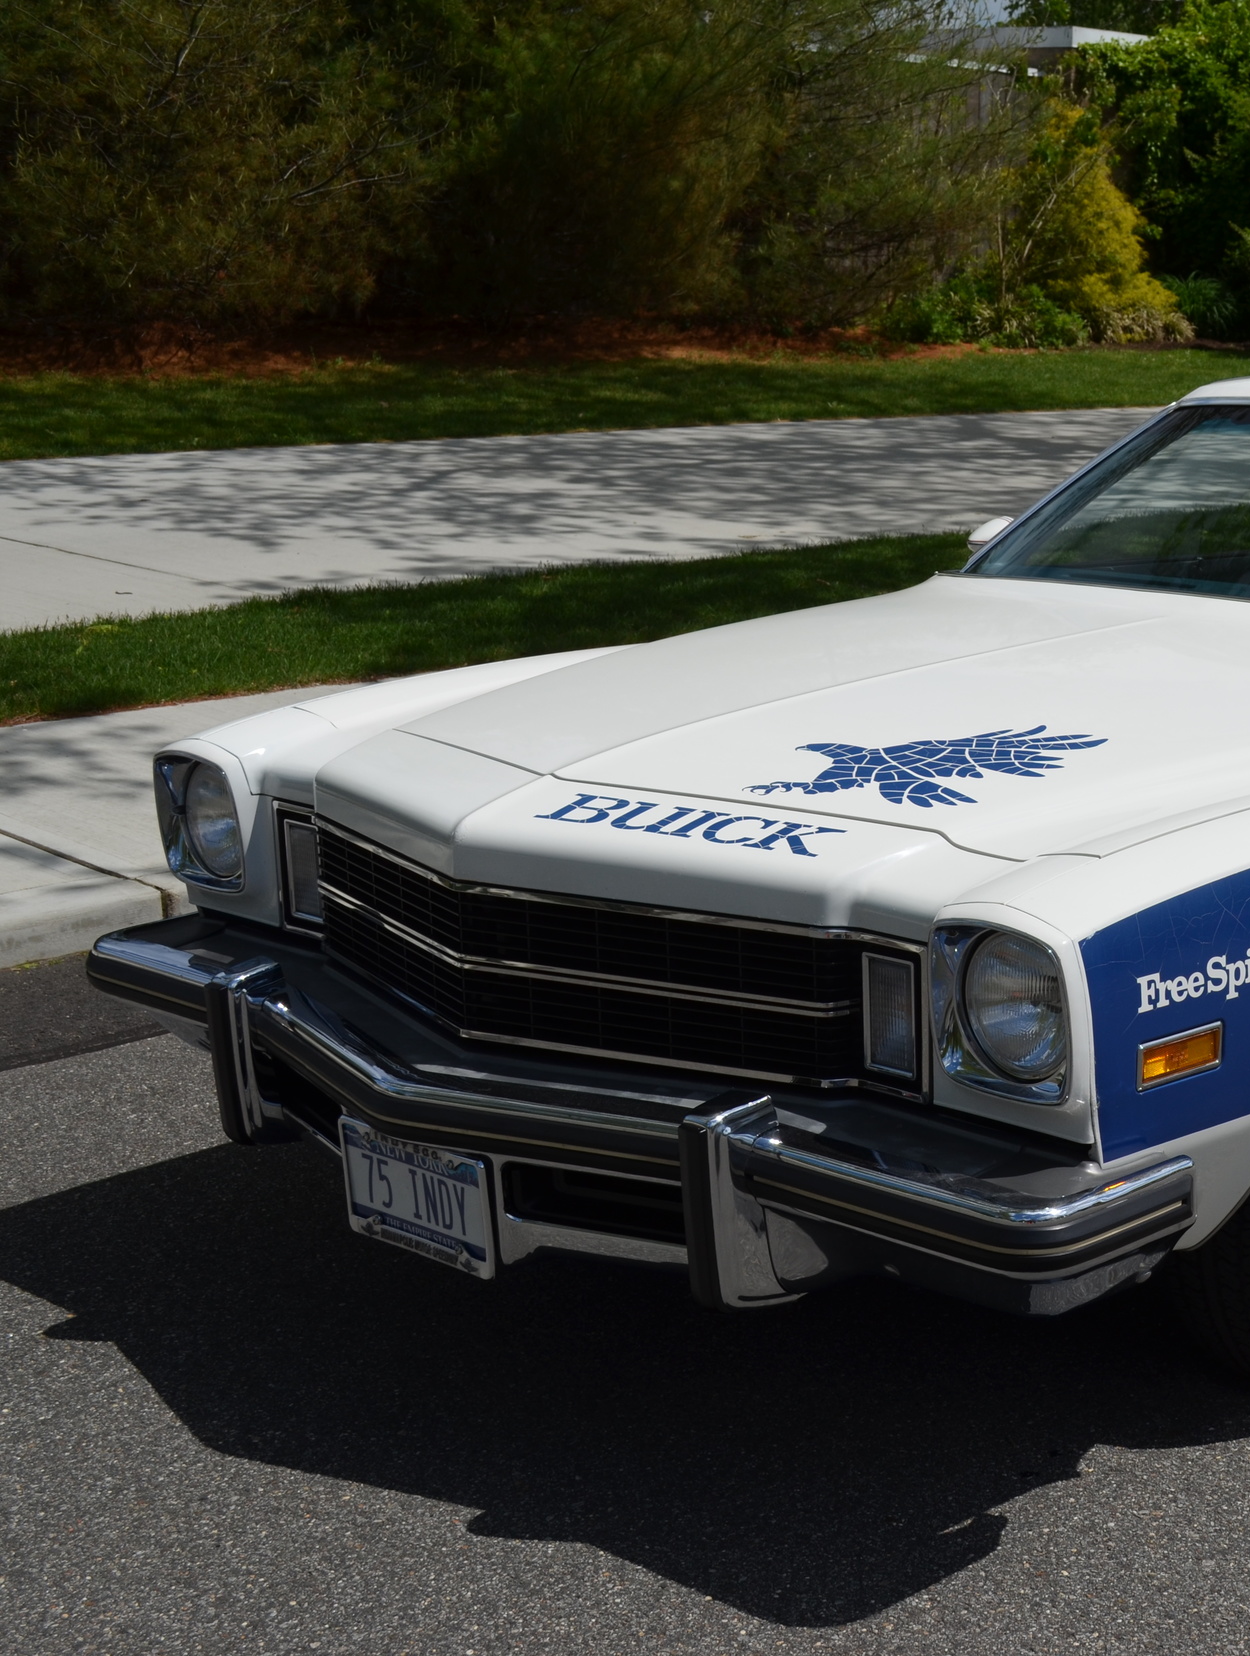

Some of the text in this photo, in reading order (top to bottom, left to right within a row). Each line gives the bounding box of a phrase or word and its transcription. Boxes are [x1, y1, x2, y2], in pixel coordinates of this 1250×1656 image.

[533, 792, 848, 858] BUICK
[376, 1142, 406, 1161] NEW
[361, 1153, 467, 1236] 75 INDY
[385, 1216, 401, 1229] THE
[403, 1222, 432, 1241] EMPIRE
